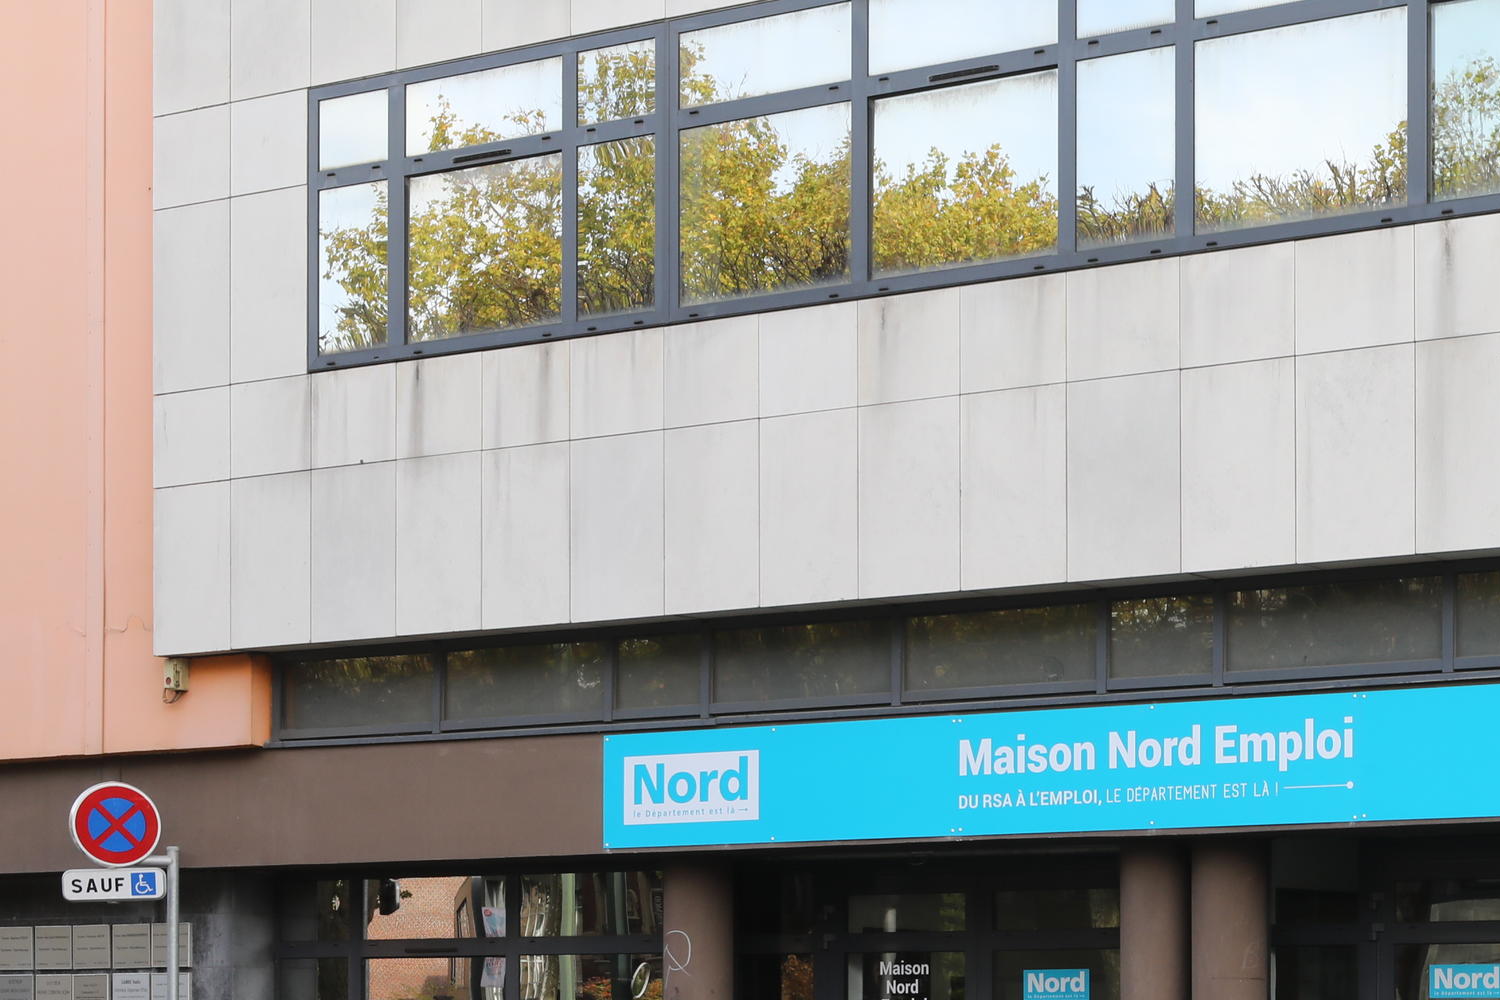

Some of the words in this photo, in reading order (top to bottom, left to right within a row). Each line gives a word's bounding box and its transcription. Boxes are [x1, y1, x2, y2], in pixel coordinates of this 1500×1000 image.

[959, 733, 1096, 776] Maison
[1108, 723, 1201, 769] Nord
[1215, 716, 1354, 772] Emploi
[633, 755, 749, 805] Nord
[958, 794, 979, 810] DU
[982, 793, 1013, 809] RSA
[1015, 789, 1026, 807] À
[1029, 789, 1103, 807] L'EMPLOI,
[1106, 787, 1122, 803] LE
[1126, 783, 1217, 803] DÉPARTEMENT
[1223, 782, 1248, 799] EST
[1253, 780, 1270, 798] LÀ
[633, 810, 642, 818] le
[645, 808, 705, 819] Département
[708, 807, 723, 816] est
[727, 806, 736, 815] là
[71, 877, 125, 894] SAUF
[879, 960, 930, 976] Maison
[1434, 966, 1500, 989] Nord
[886, 979, 919, 994] Nord
[1027, 971, 1086, 993] Nord
